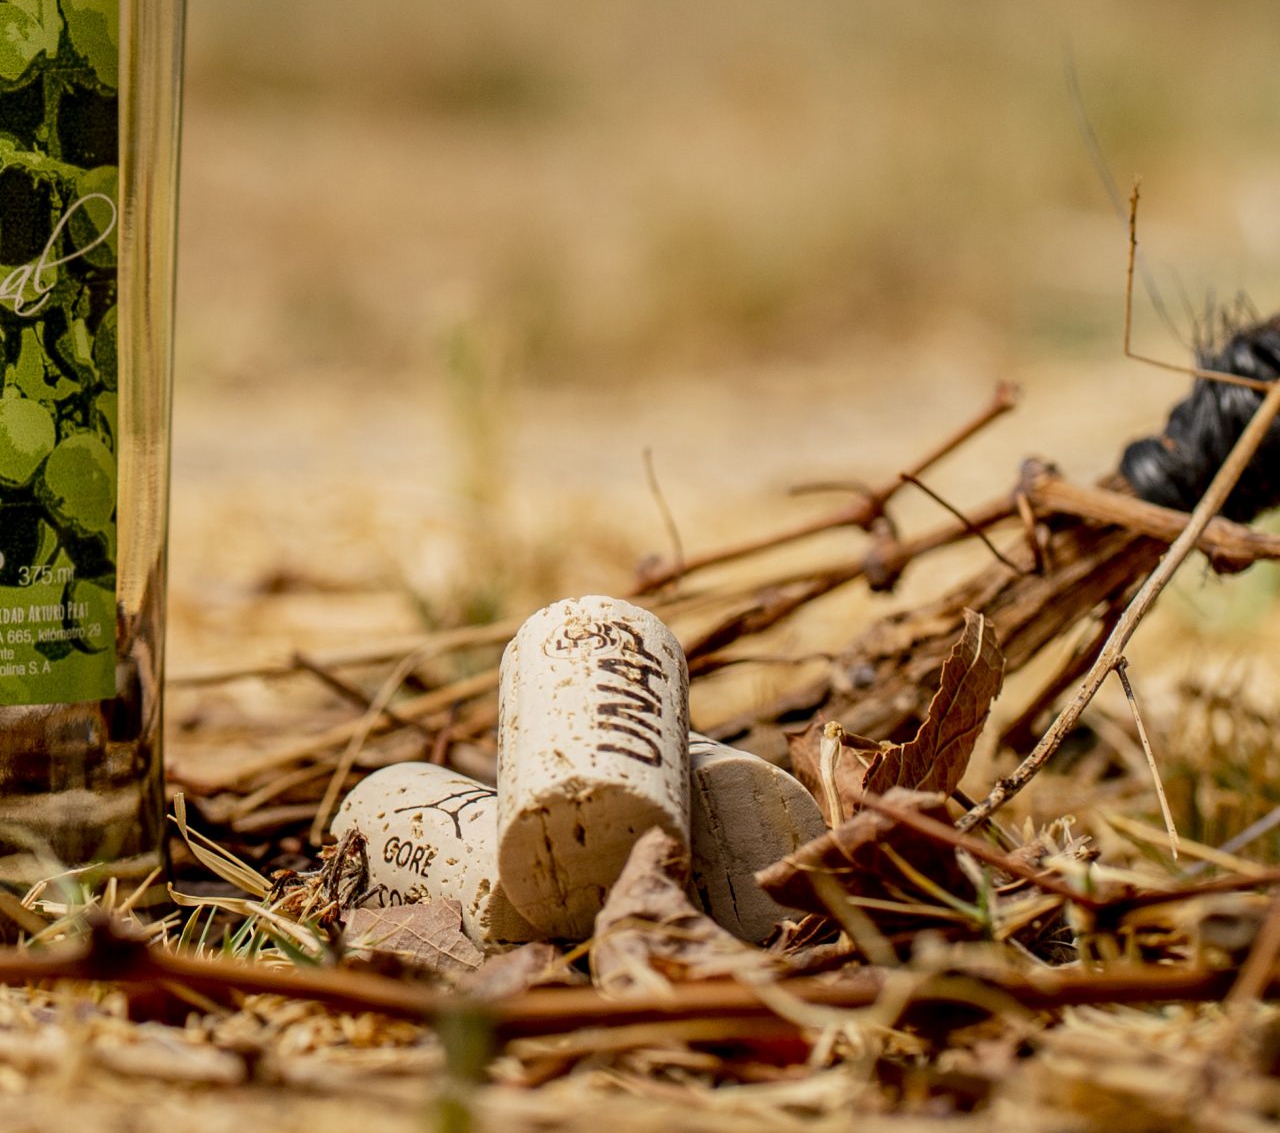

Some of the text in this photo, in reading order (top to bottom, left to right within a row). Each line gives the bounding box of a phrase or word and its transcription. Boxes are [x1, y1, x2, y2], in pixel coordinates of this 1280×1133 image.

[28, 603, 65, 623] ARTURO
[7, 629, 35, 644] 665,
[596, 620, 662, 767] UNAP
[383, 836, 437, 878] GORE
